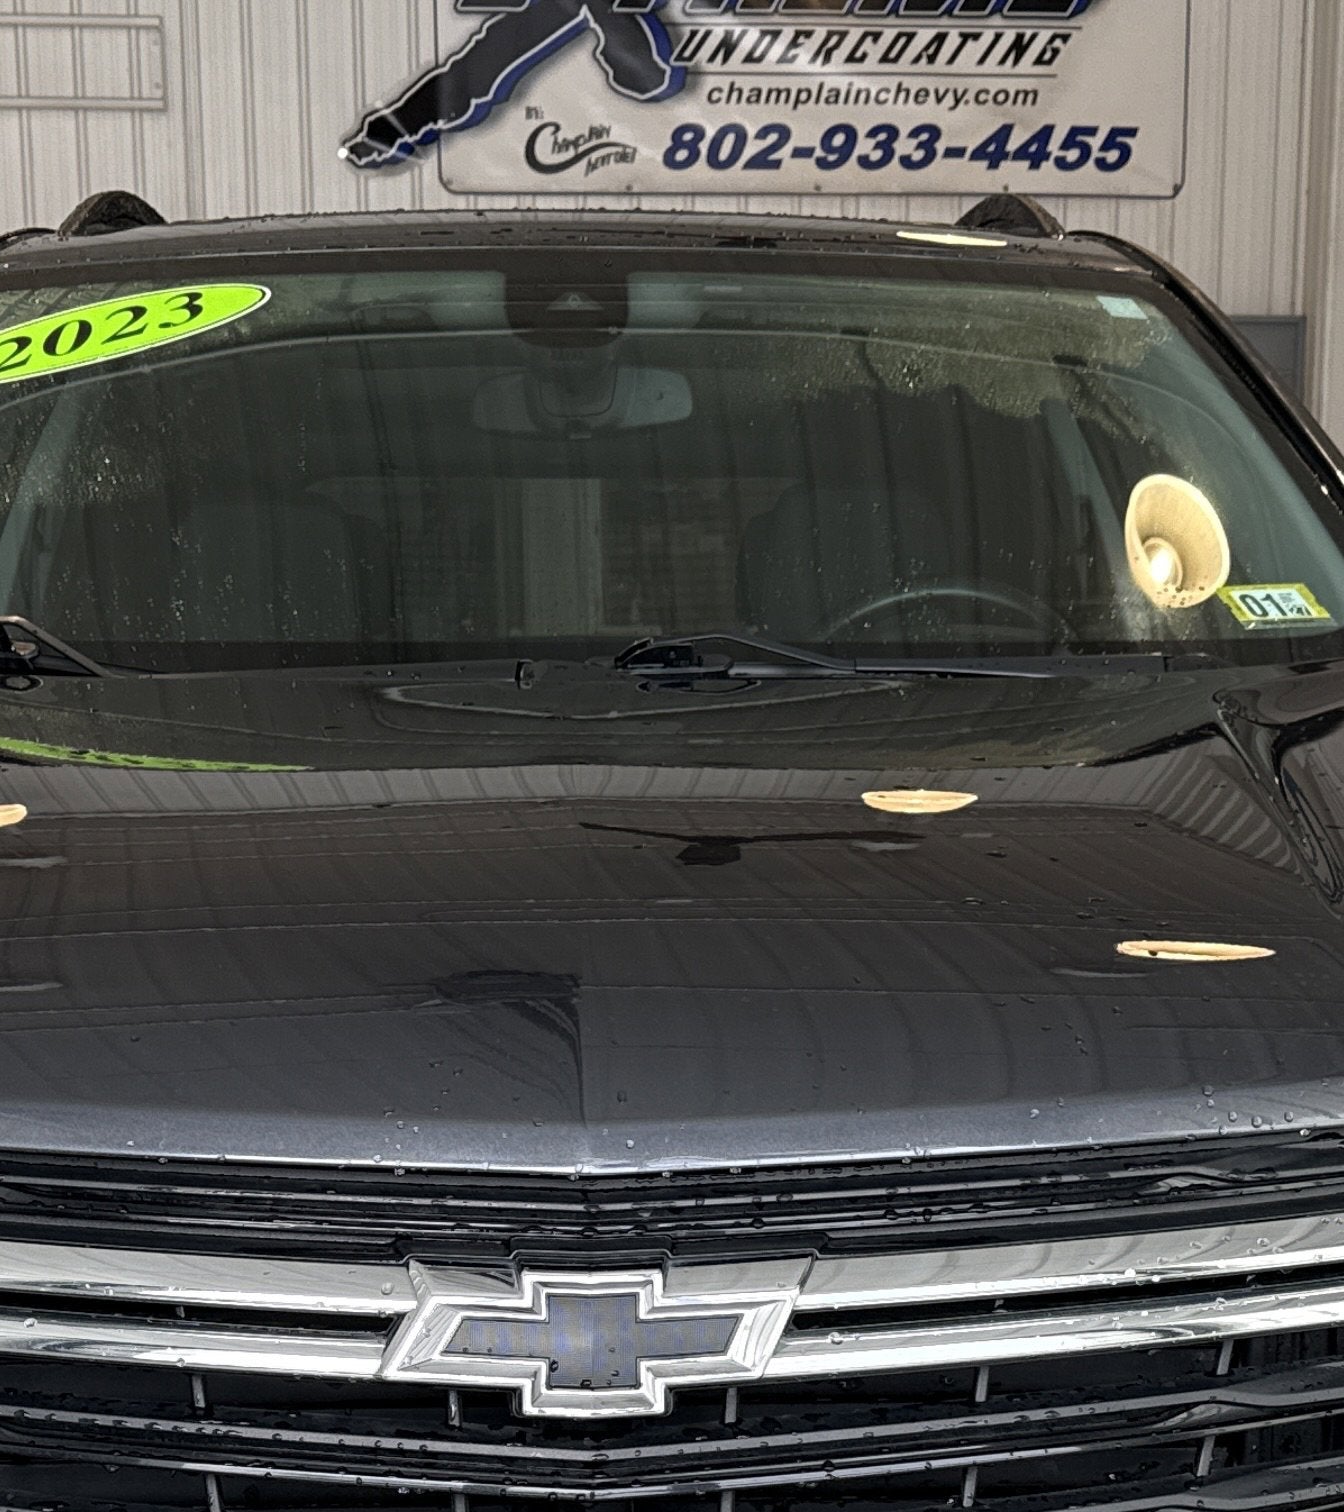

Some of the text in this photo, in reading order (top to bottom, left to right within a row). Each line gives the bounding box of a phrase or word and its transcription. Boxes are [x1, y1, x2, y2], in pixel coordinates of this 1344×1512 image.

[672, 27, 1072, 68] UNDERCOATING
[707, 81, 1039, 110] champlainchevy.com
[662, 122, 1140, 172] 802-933-4455
[1239, 593, 1287, 617] 01
